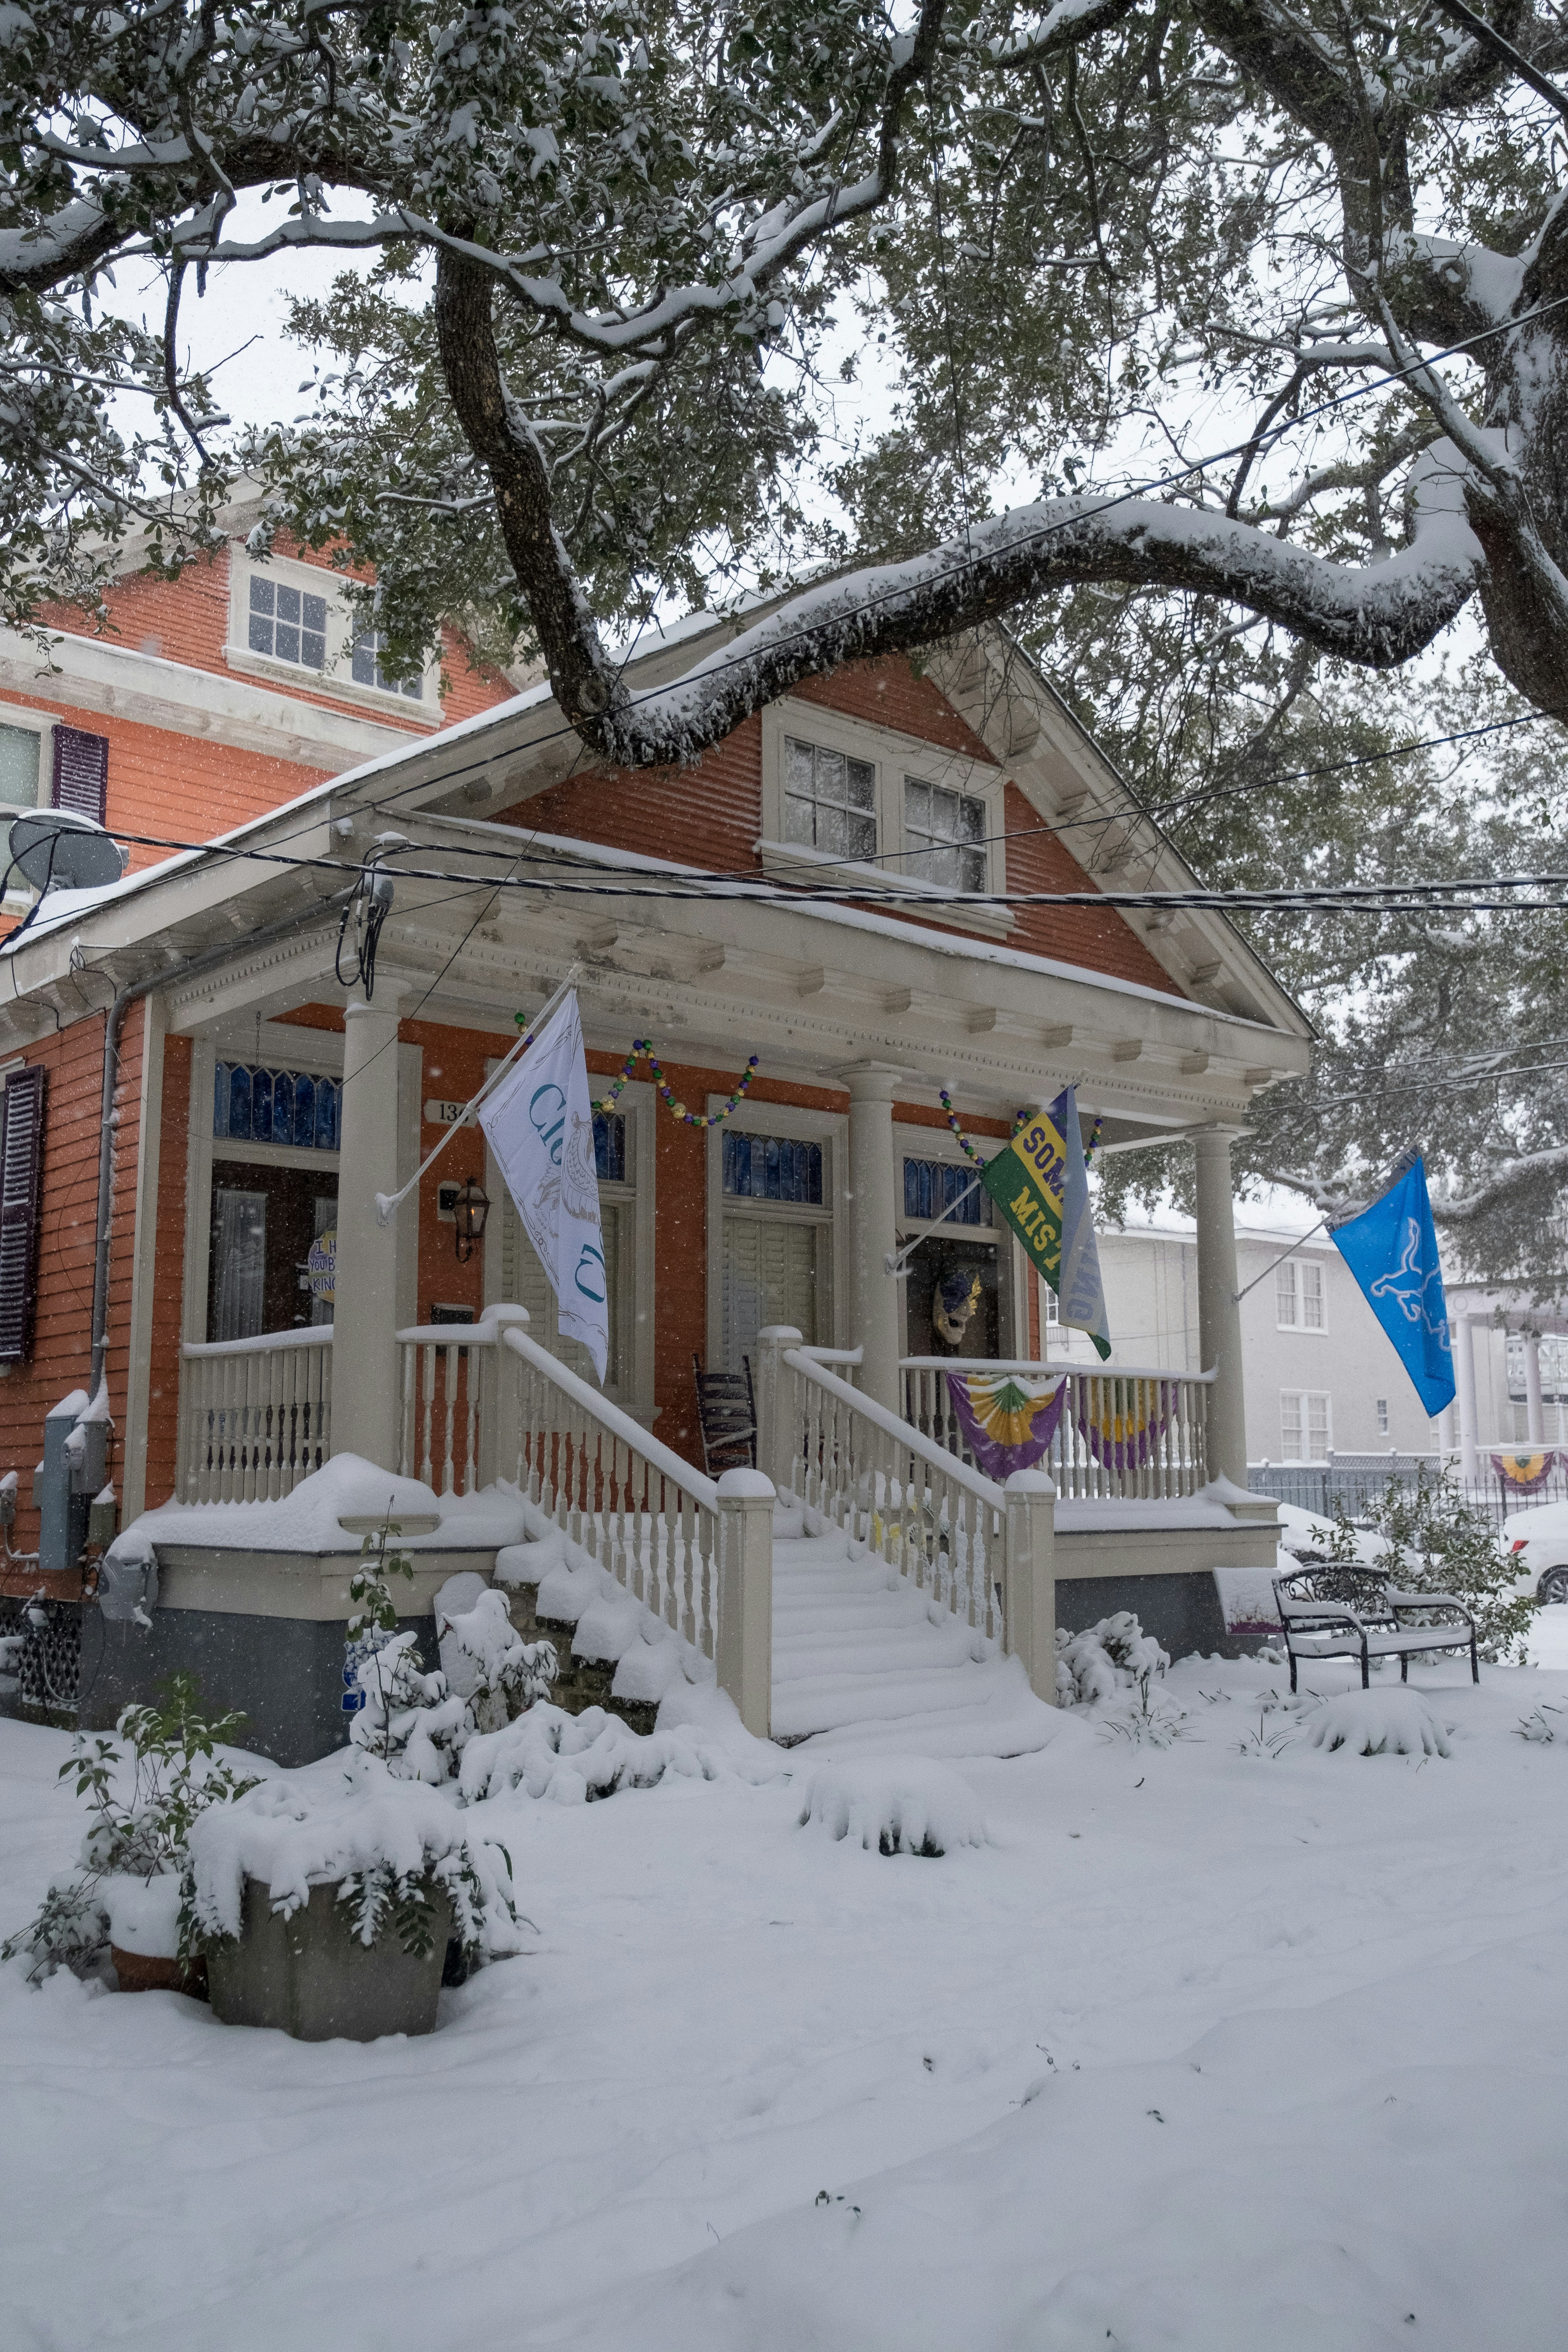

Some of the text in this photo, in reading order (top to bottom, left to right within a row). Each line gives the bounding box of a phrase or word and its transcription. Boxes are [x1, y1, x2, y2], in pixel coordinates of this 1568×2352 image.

[1023, 1127, 1064, 1206] SOM
[315, 1240, 323, 1254] I
[1009, 1185, 1062, 1271] MIST
[309, 1259, 325, 1272] YOU
